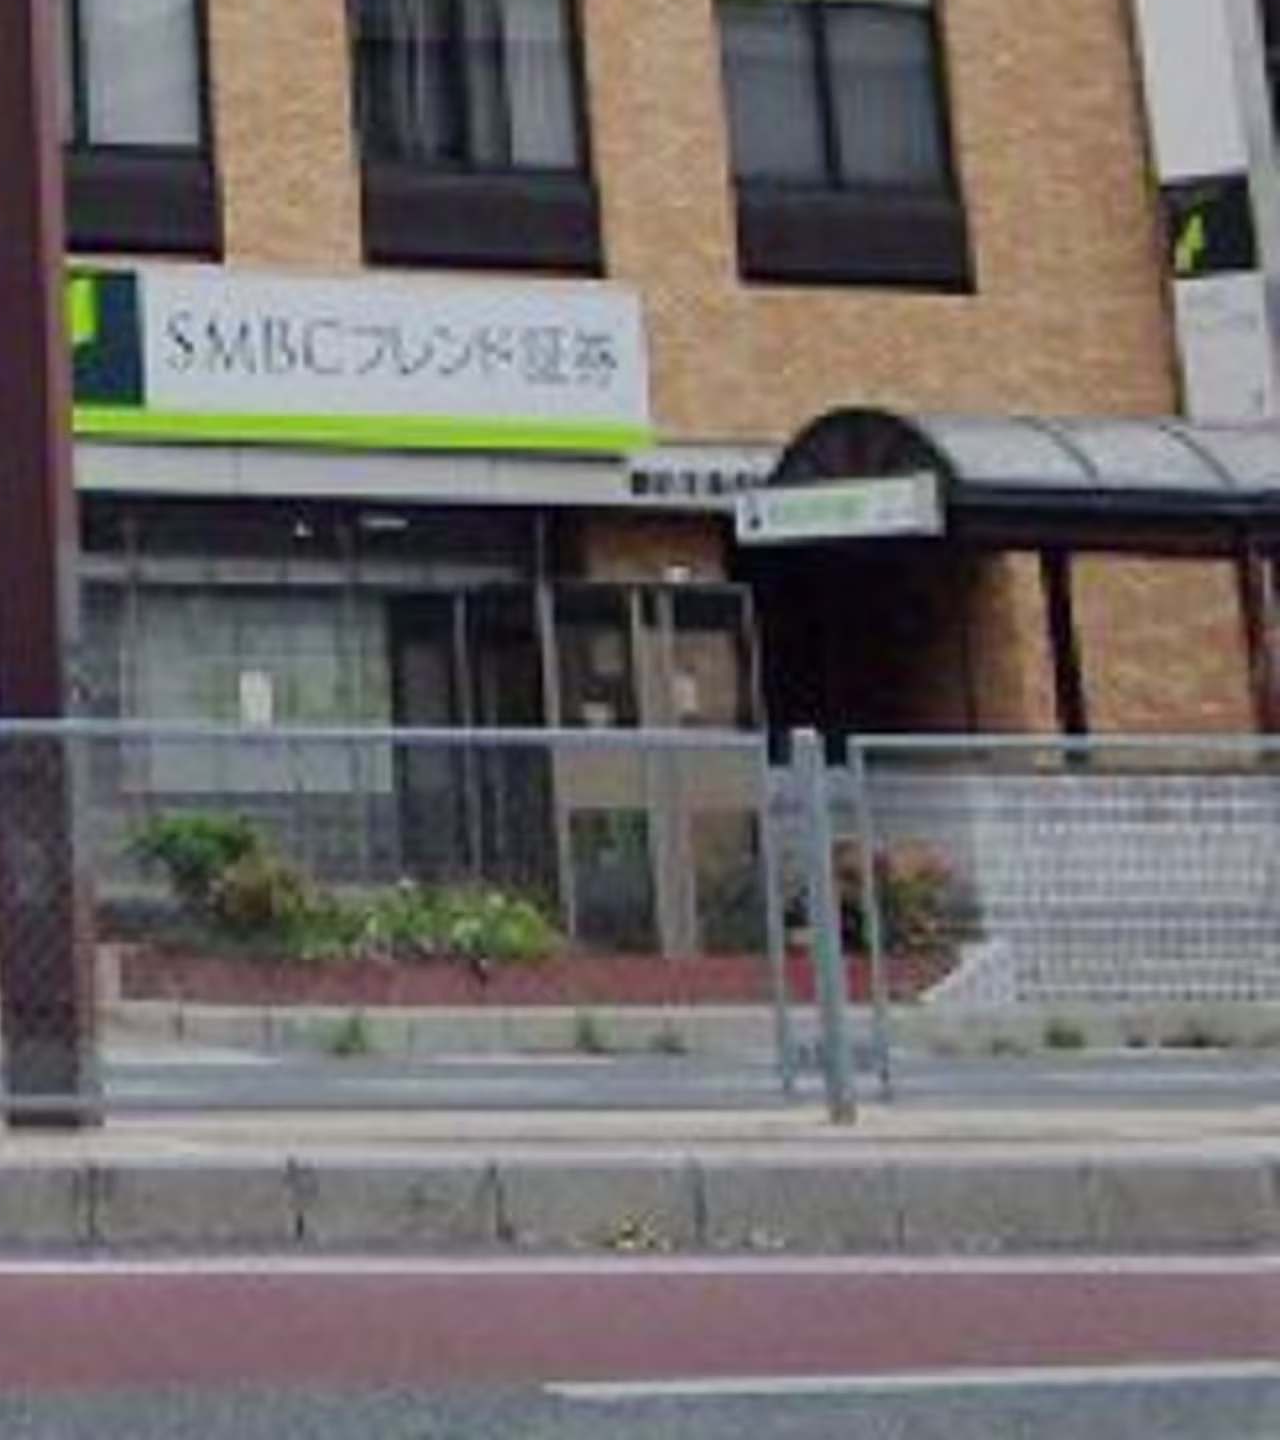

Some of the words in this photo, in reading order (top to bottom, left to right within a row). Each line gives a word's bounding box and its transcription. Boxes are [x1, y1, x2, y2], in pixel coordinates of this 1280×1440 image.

[164, 311, 620, 388] SMBCフレンド証券
